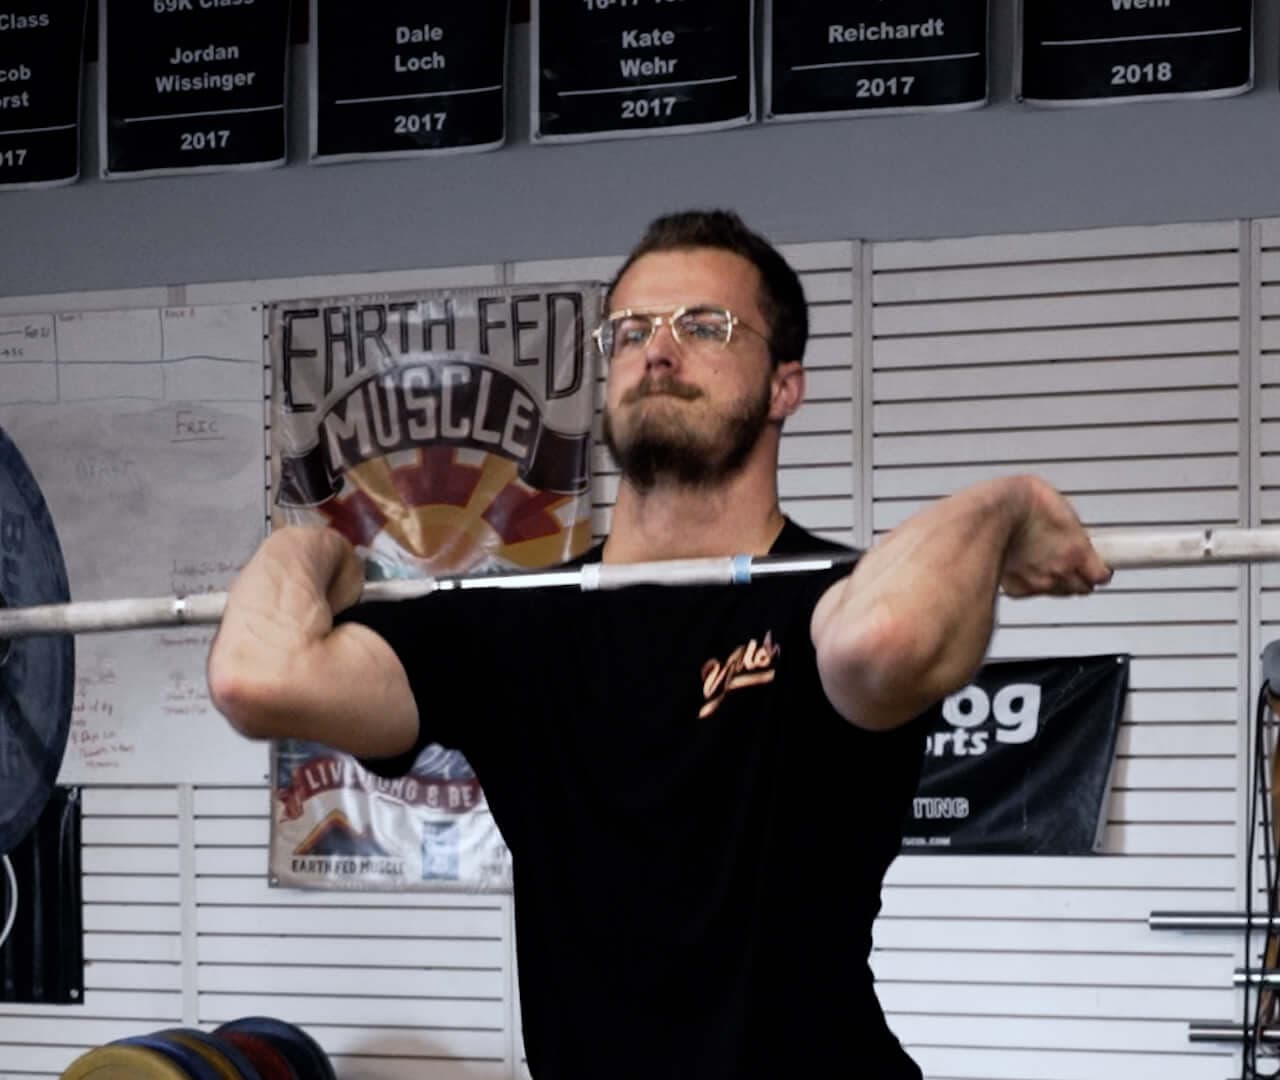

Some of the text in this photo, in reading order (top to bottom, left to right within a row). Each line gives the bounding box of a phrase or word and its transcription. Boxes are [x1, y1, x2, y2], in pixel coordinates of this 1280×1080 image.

[396, 23, 444, 45] Dale
[621, 28, 675, 49] Kate
[828, 18, 945, 44] Reichardt
[169, 44, 239, 65] Jordan
[394, 51, 446, 73] Loch
[620, 56, 678, 78] Wehr
[1111, 61, 1172, 85] 2018
[155, 71, 256, 93] Wissinger
[855, 76, 915, 98] 2017
[621, 96, 678, 119] 2017
[394, 112, 447, 134] 2017
[180, 129, 231, 151] 2017
[282, 291, 587, 414] EARTH FED
[325, 363, 535, 463] MUSCLE
[941, 683, 1042, 745] og
[925, 728, 990, 756] rts
[291, 859, 332, 874] EARTH
